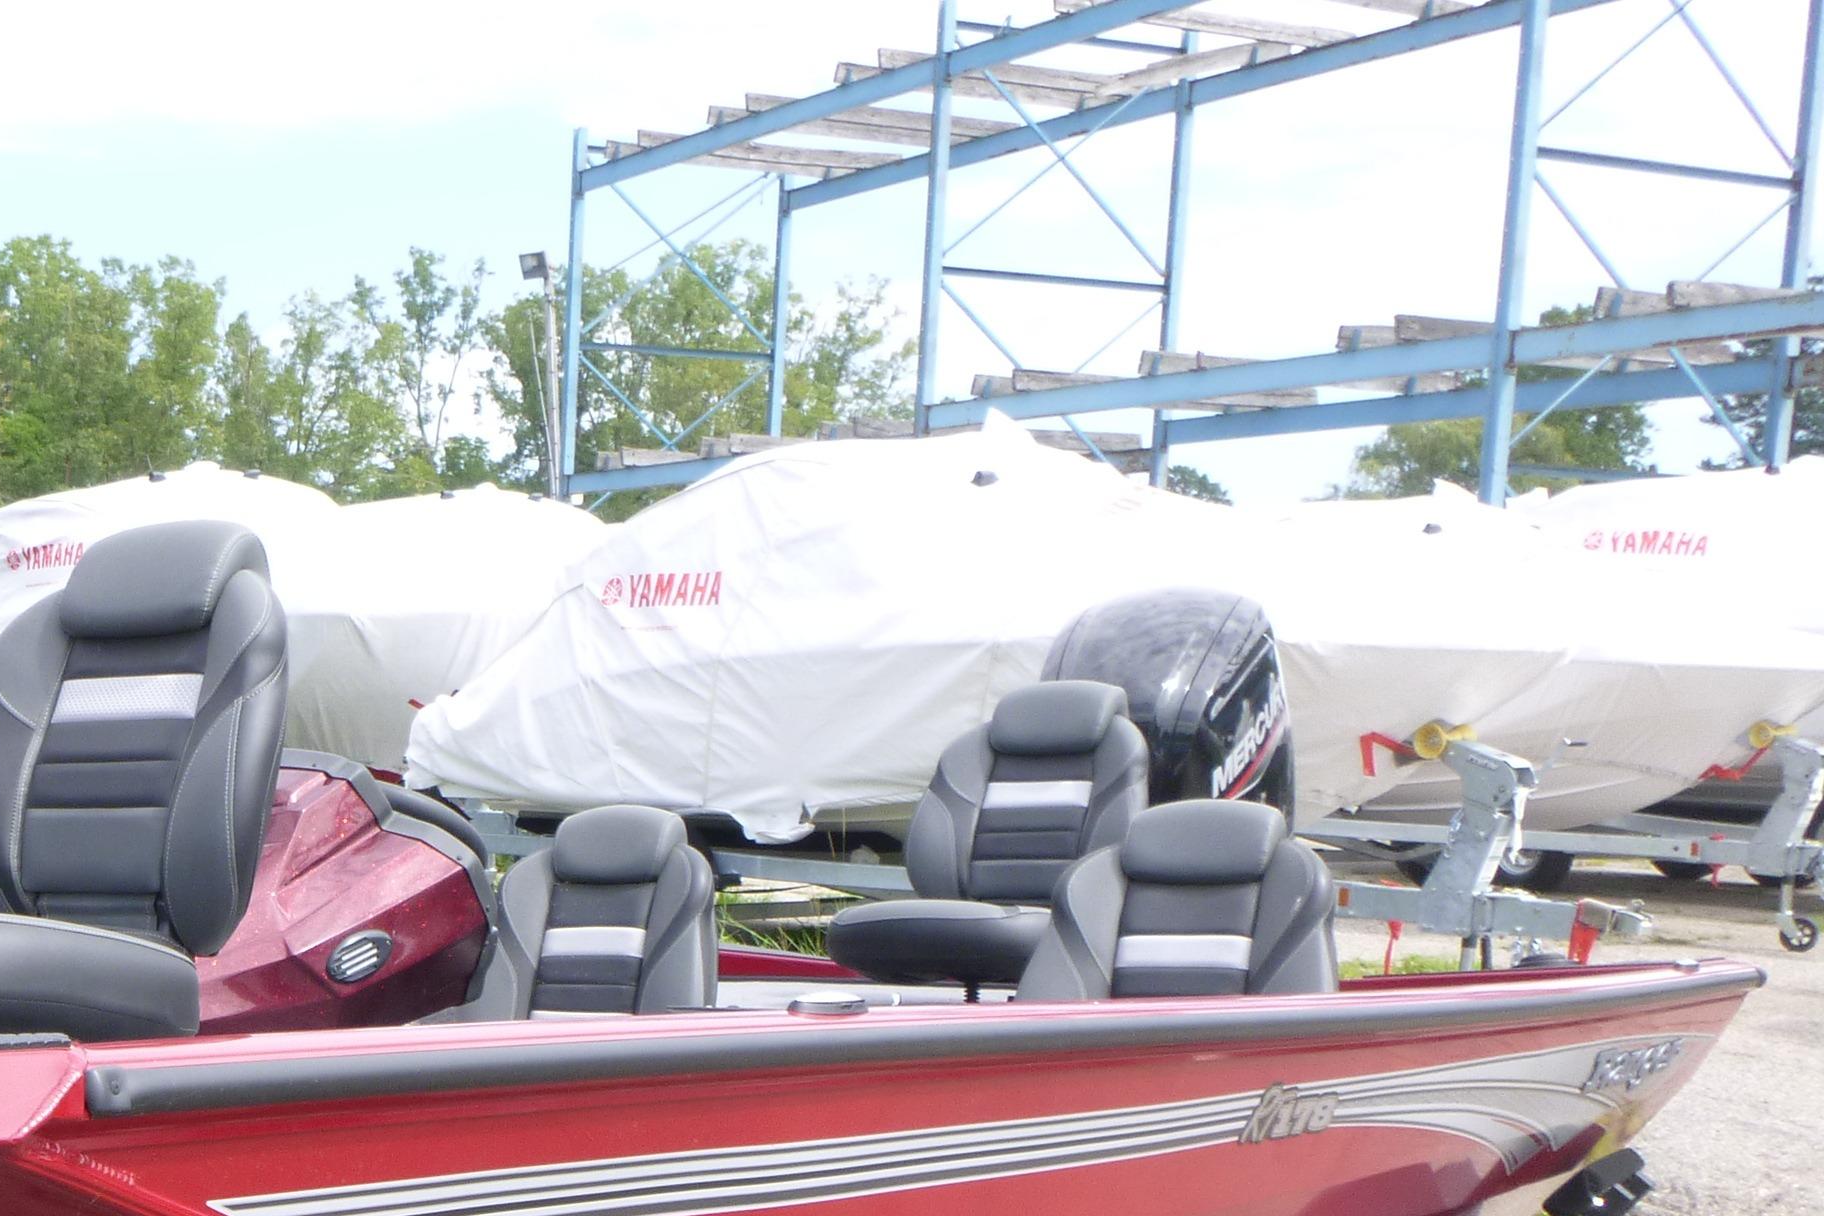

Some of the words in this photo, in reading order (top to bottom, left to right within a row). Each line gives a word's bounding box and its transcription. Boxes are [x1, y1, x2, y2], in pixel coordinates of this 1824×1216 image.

[22, 542, 84, 571] YAMAHA
[1611, 530, 1708, 557] YAMAHA
[629, 571, 722, 608] YAMAHA
[1212, 672, 1285, 799] MERCUR
